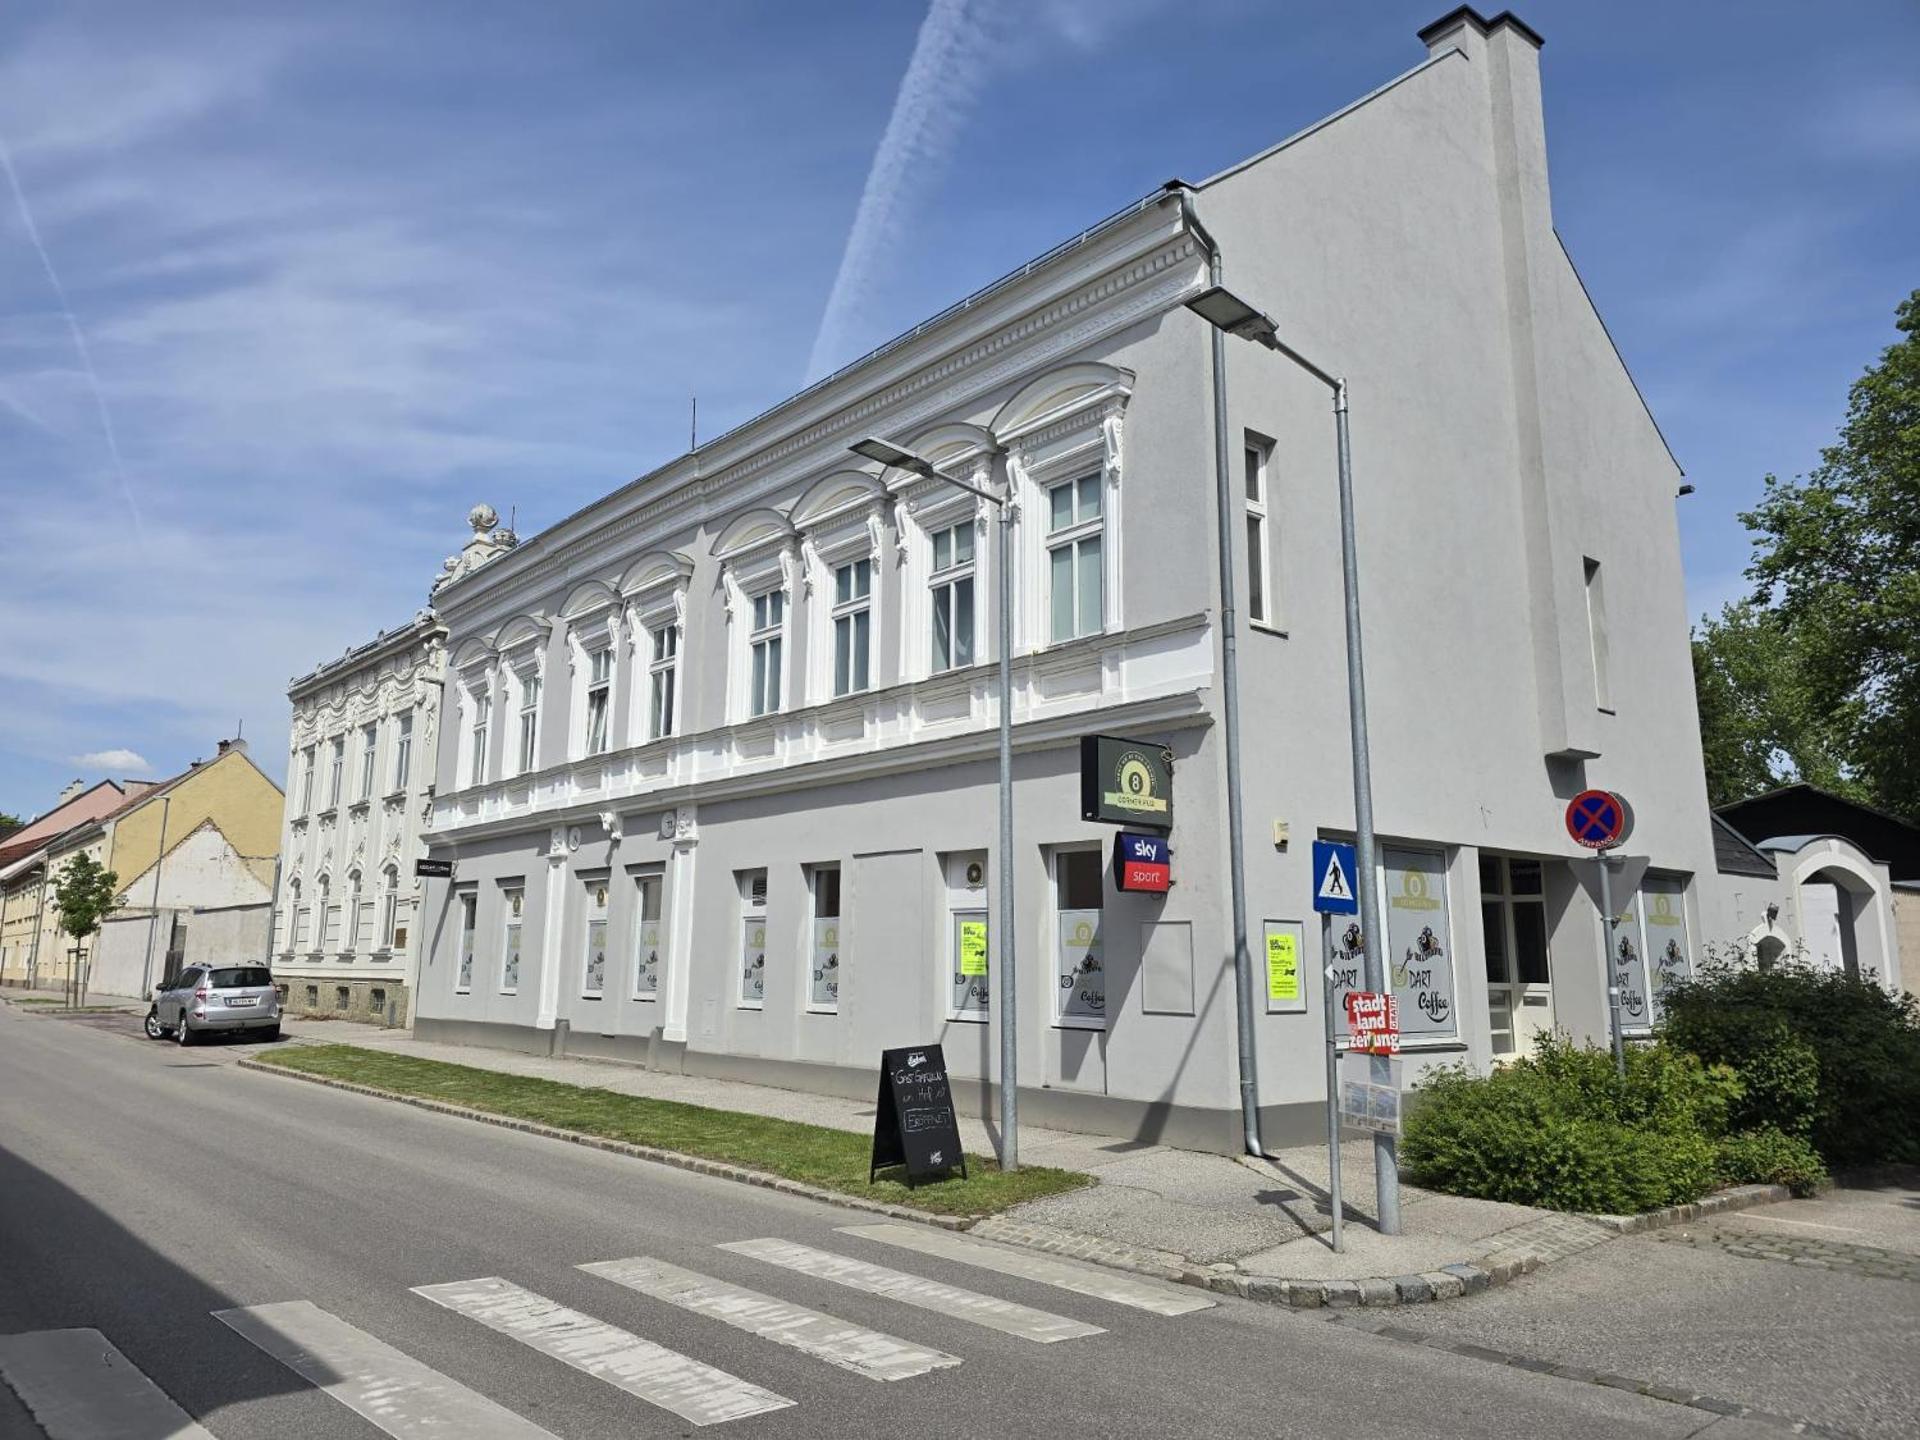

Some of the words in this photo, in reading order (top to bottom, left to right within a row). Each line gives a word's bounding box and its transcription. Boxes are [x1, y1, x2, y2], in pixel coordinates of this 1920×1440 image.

[1132, 775, 1139, 791] 8
[1134, 839, 1157, 861] sky
[1133, 871, 1161, 884] sport
[1333, 968, 1357, 989] DART
[1409, 969, 1432, 989] DART
[1353, 993, 1387, 1012] stadt
[1389, 995, 1399, 1029] GRATIS
[1418, 991, 1449, 1016] Coffee
[1356, 1010, 1386, 1029] land
[1350, 1030, 1399, 1052] zeitung
